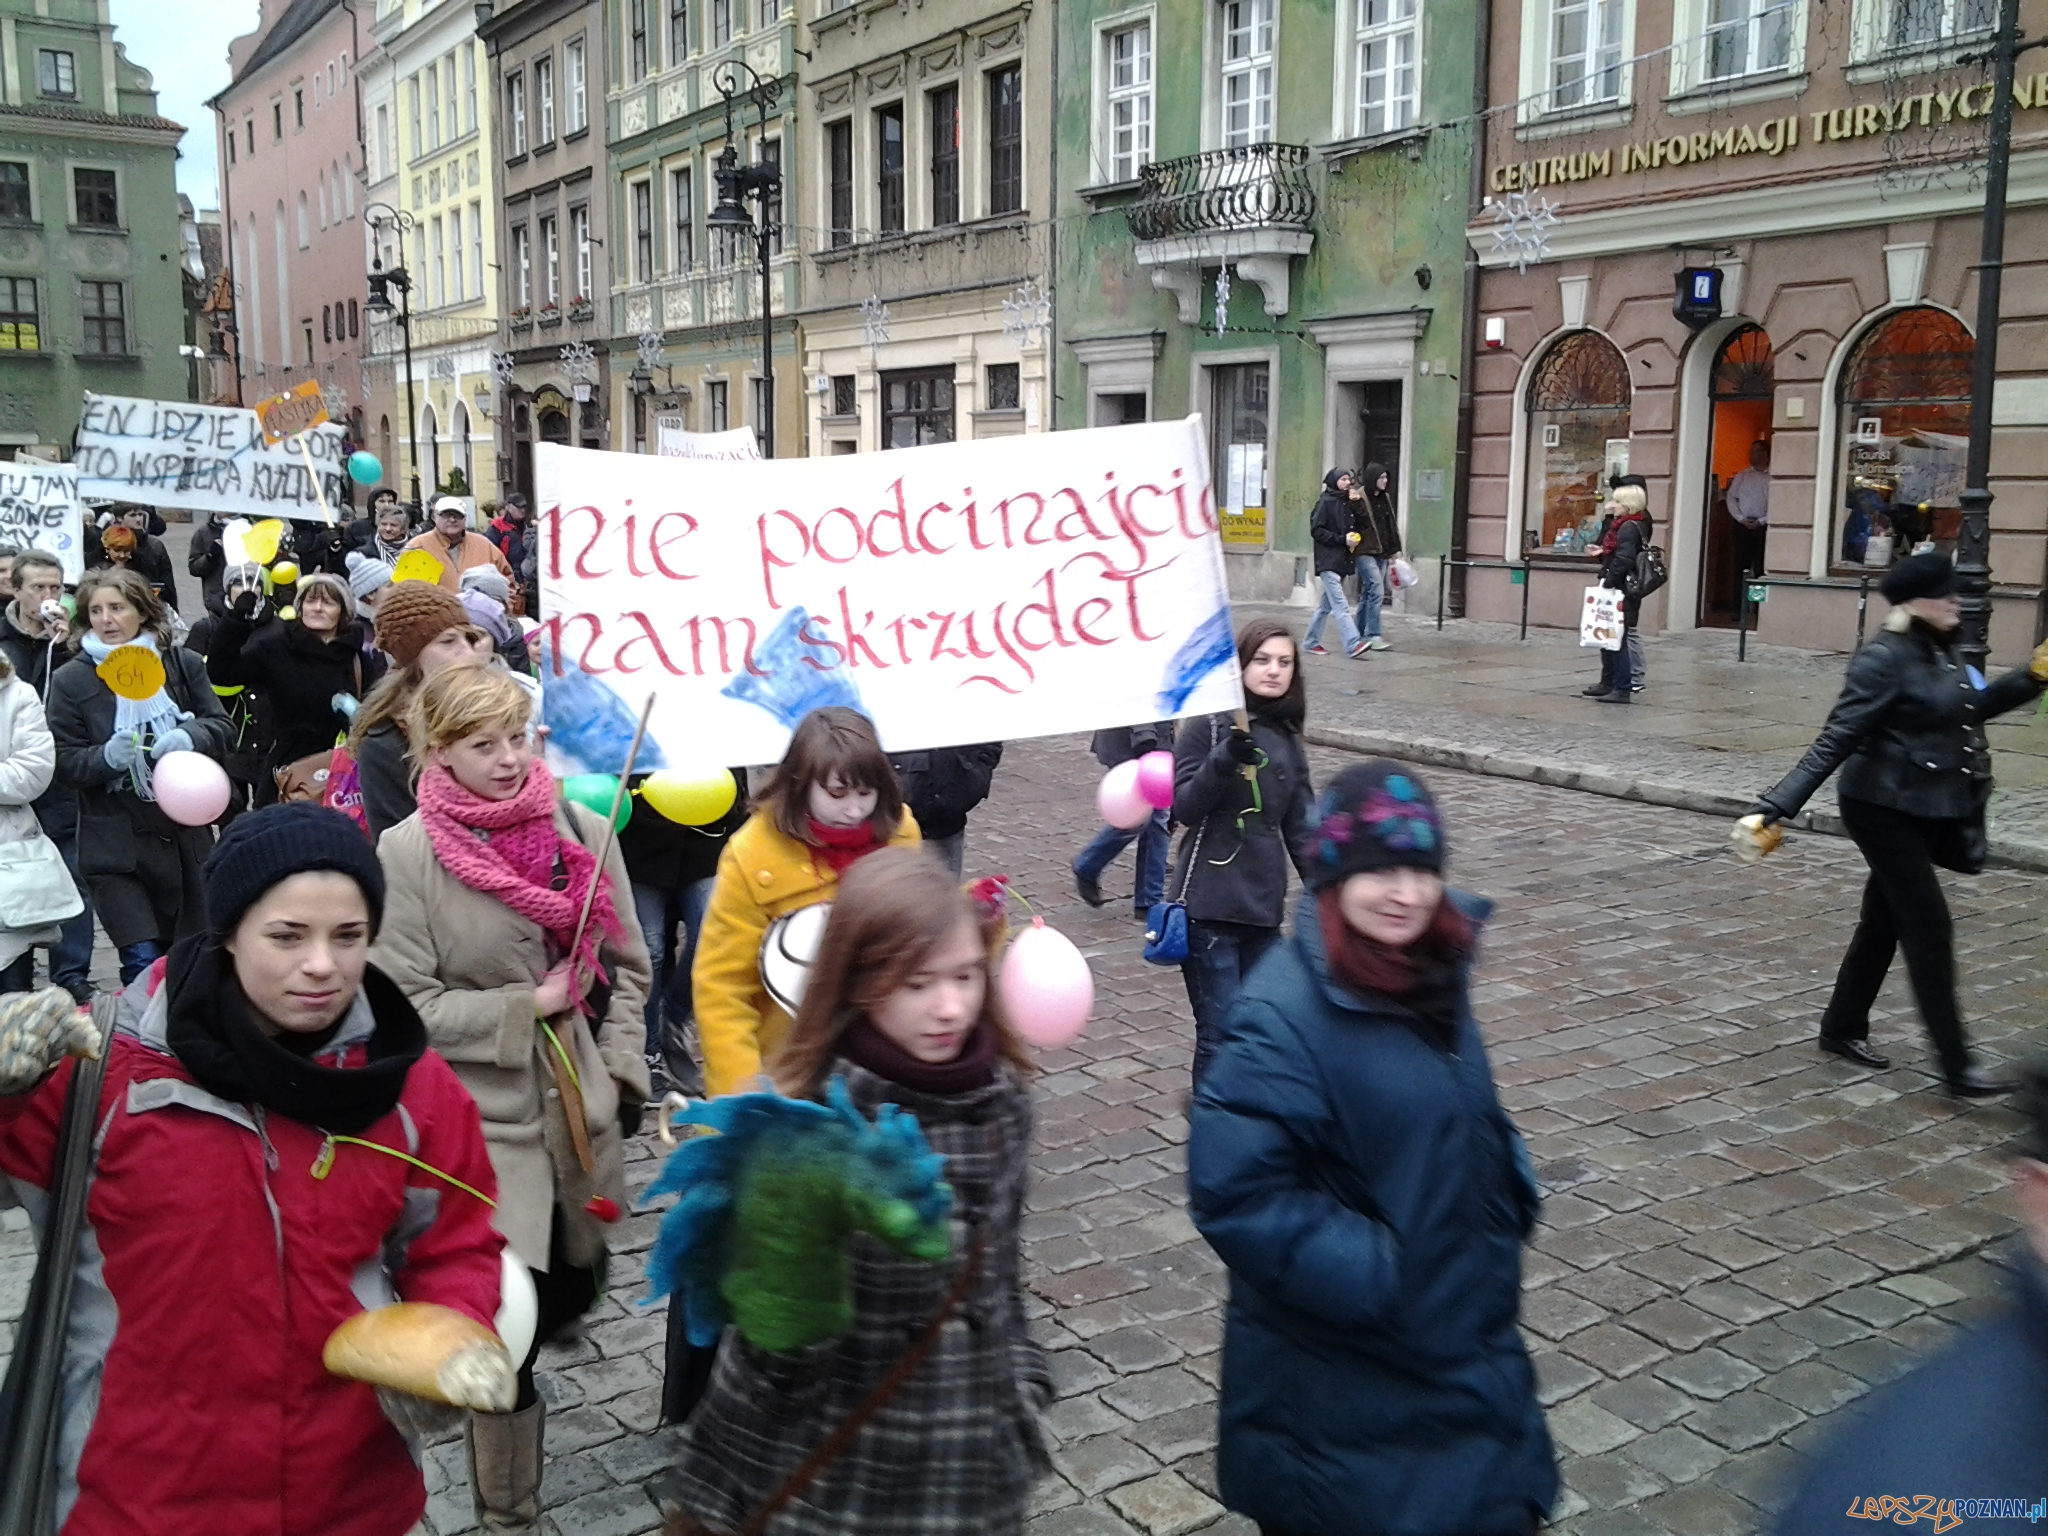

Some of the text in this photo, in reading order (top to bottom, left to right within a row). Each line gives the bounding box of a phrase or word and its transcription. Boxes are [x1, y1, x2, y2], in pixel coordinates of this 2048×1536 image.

[1490, 148, 1612, 192] CENTRUM
[1621, 115, 1799, 173] INFORMACJI
[536, 498, 701, 581] nie
[538, 609, 776, 678] nam
